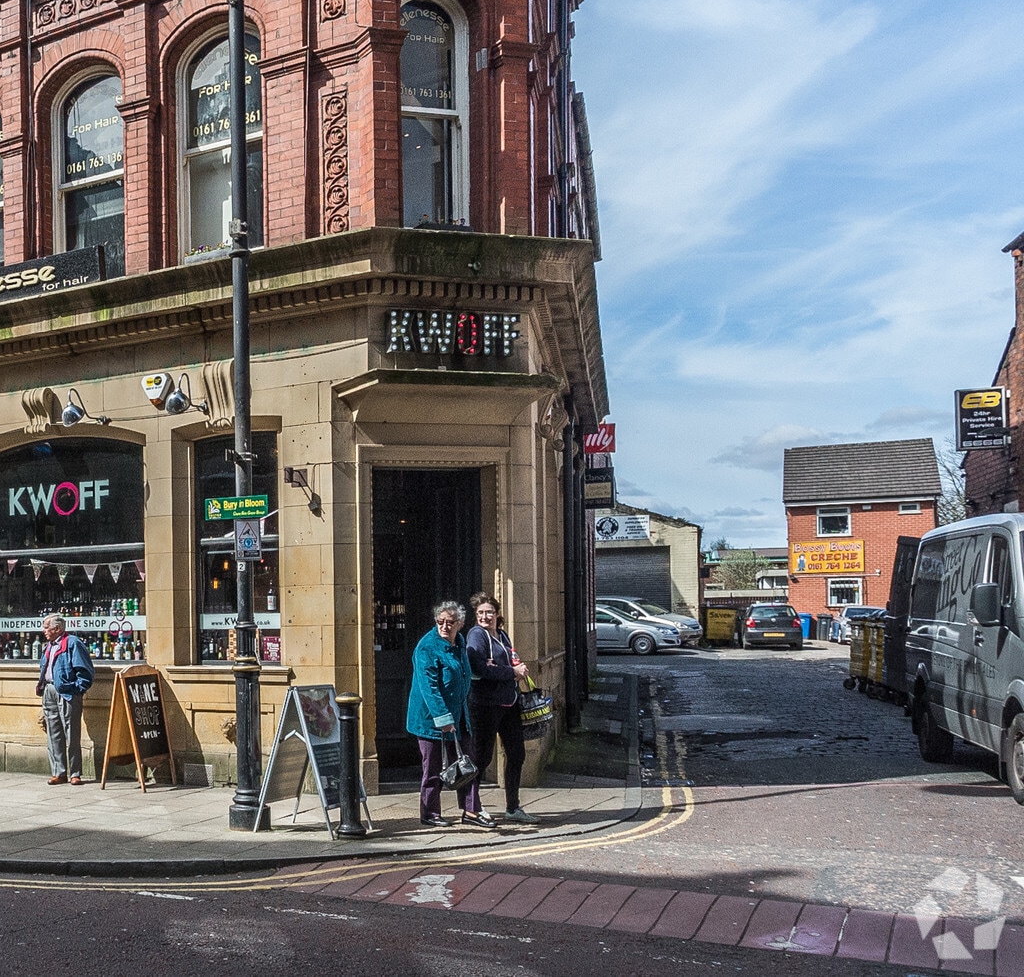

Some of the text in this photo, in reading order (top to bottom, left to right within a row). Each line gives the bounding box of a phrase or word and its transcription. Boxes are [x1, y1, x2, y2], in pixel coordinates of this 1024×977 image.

[400, 9, 450, 32] ellenesse
[419, 88, 432, 98] 763
[435, 90, 451, 99] 1361
[193, 110, 260, 137] 0161 76 361
[67, 151, 122, 175] 0161 763 136
[42, 275, 89, 292] for hair
[386, 309, 520, 356] KWOFF
[9, 479, 110, 516] KWOFF
[223, 500, 237, 511] Bury
[245, 499, 265, 507] Bloom
[794, 541, 861, 554] Bossy Boots
[811, 553, 858, 562] CRECHE
[826, 562, 840, 570] 764
[1, 620, 43, 629] INDEPEND
[83, 619, 106, 628] SHOP
[135, 705, 160, 726] SHOP
